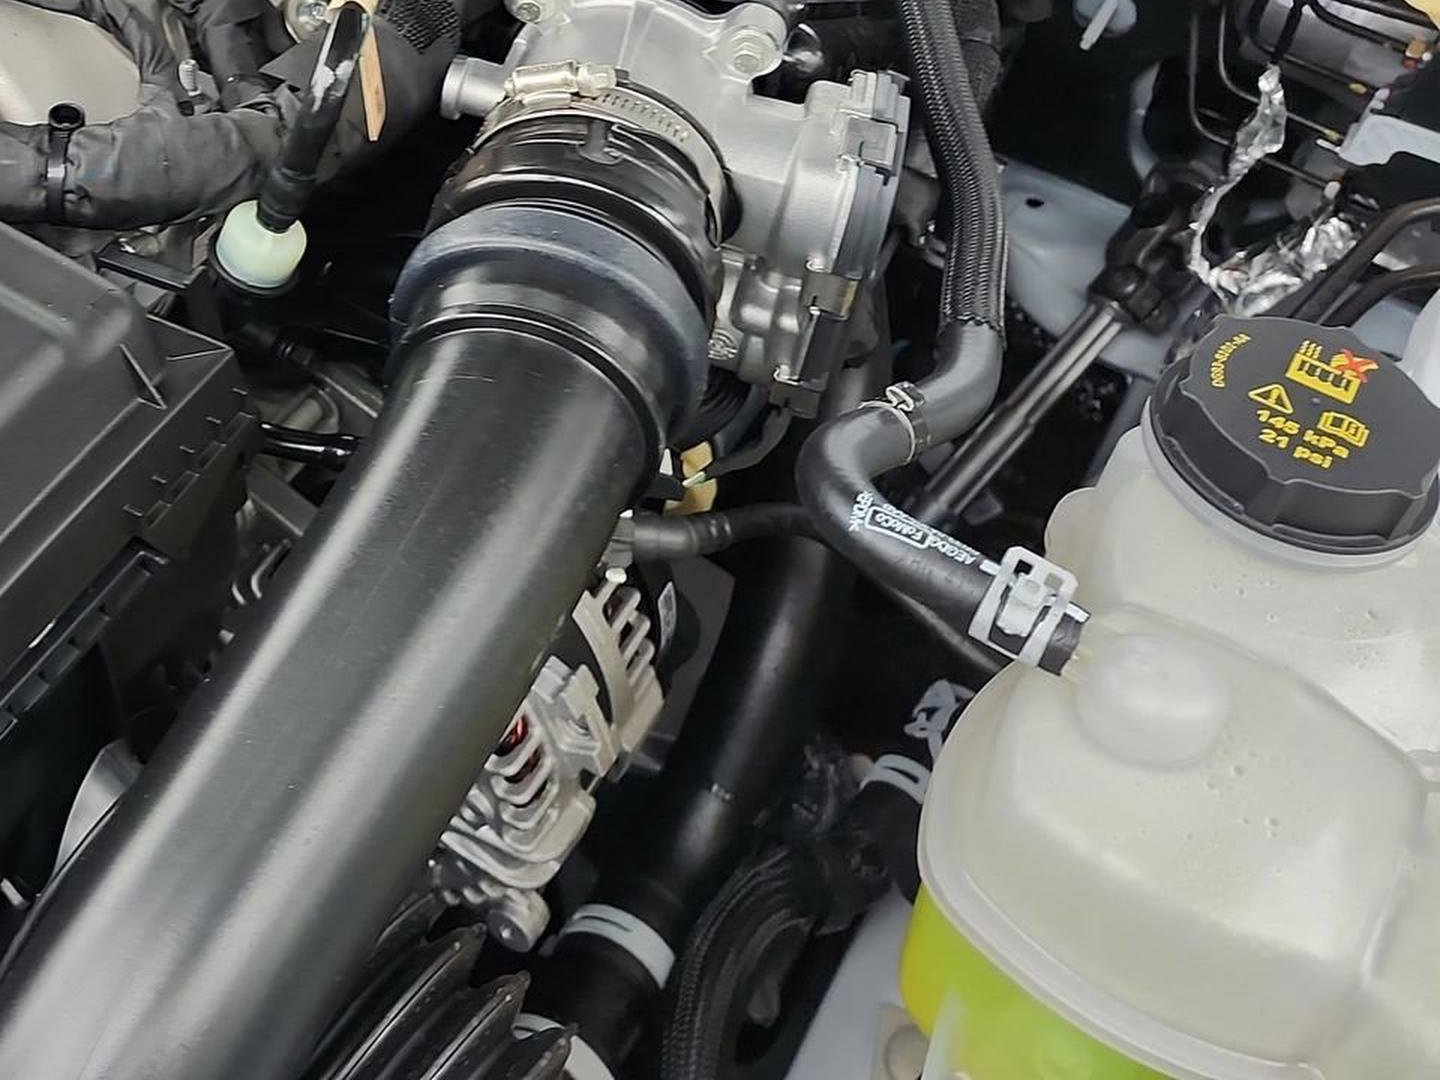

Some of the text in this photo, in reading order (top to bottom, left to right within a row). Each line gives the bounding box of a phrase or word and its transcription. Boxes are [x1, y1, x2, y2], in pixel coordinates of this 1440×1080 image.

[1256, 409, 1350, 459] 145 kPa
[1258, 428, 1333, 469] 21 psi
